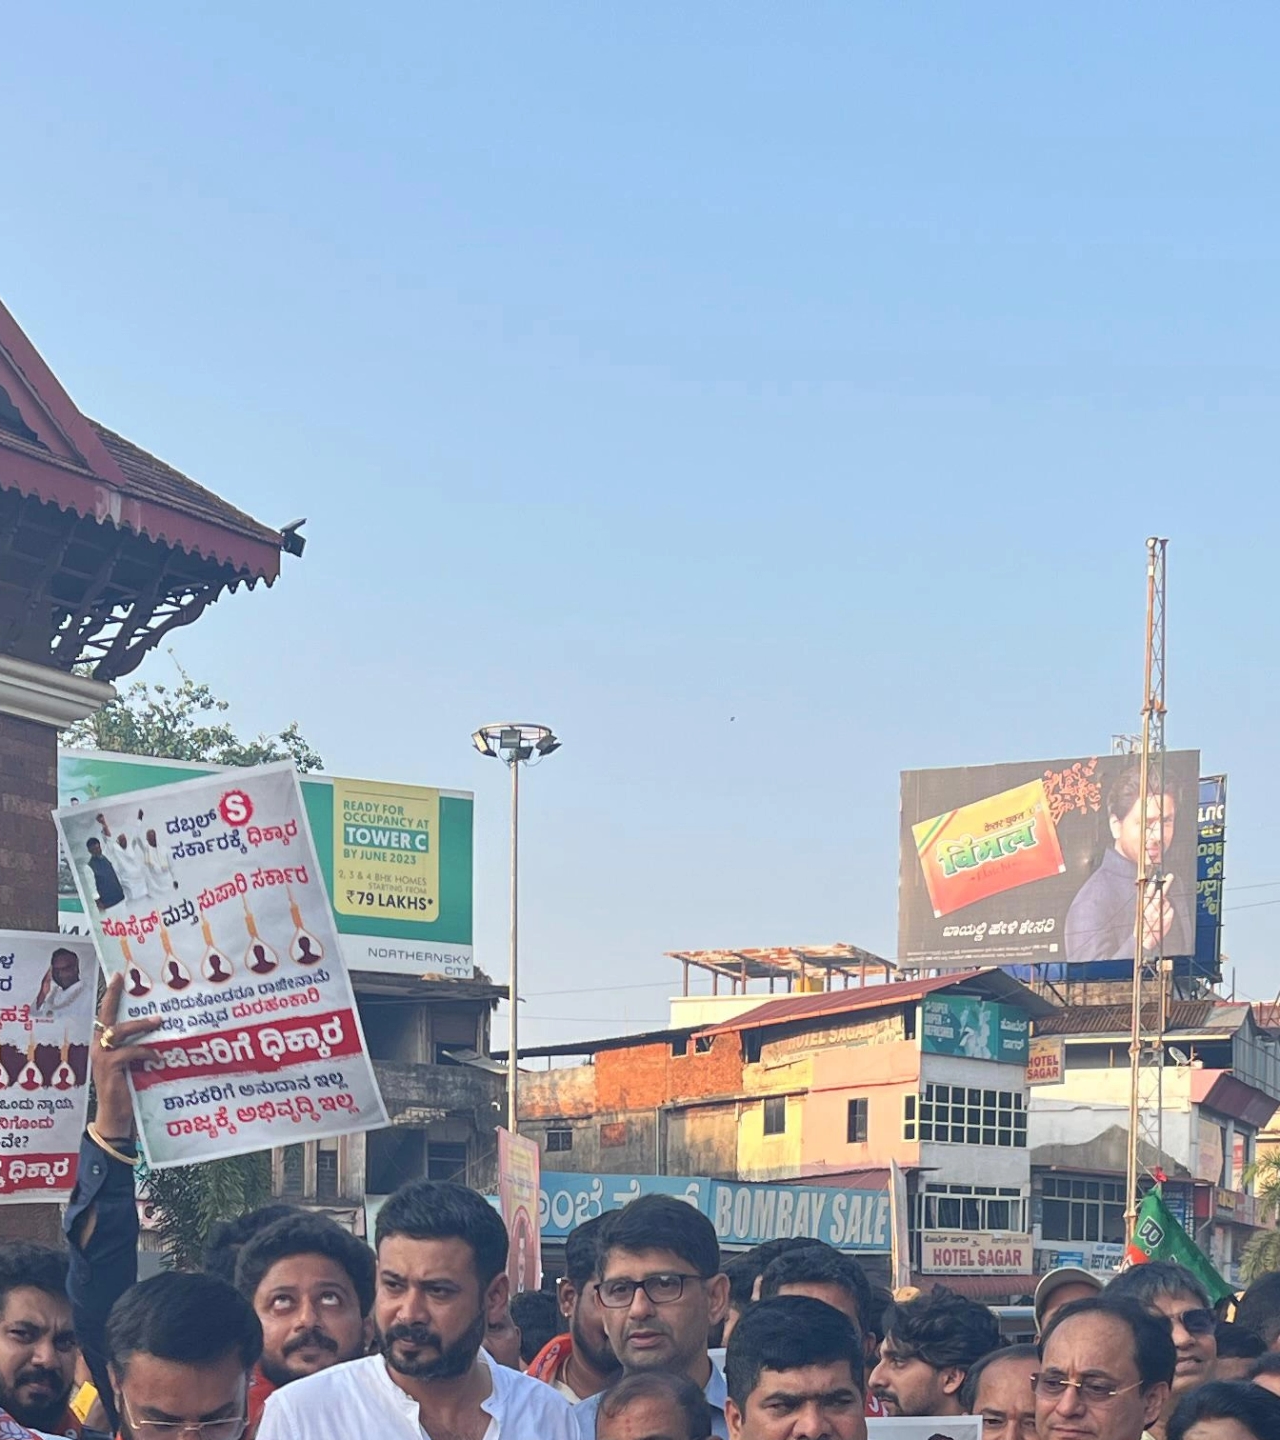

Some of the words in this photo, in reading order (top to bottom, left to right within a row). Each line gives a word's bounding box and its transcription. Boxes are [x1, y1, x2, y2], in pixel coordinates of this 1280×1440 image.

[343, 800, 379, 812] READY
[383, 805, 404, 815] FOR
[165, 808, 216, 840] ಡಬ್ಬಲ್
[343, 812, 413, 828] OCCUPANCY
[416, 820, 429, 829] AT
[346, 828, 411, 849] TOWER
[415, 835, 426, 850] C
[343, 849, 357, 858] BY
[360, 851, 387, 862] JUNE
[390, 854, 416, 864] 2023
[395, 877, 427, 885] HOMES
[368, 948, 470, 964] NORTHERNSKY
[445, 967, 470, 976] CITY
[259, 1022, 344, 1060] ಧಿಕ್ಕಾರ
[1027, 1067, 1058, 1079] SAGAR
[717, 1192, 823, 1239] BOMBAY
[829, 1197, 889, 1245] SALE
[933, 1249, 974, 1266] HOTEL
[978, 1250, 1022, 1266] SAGAR
